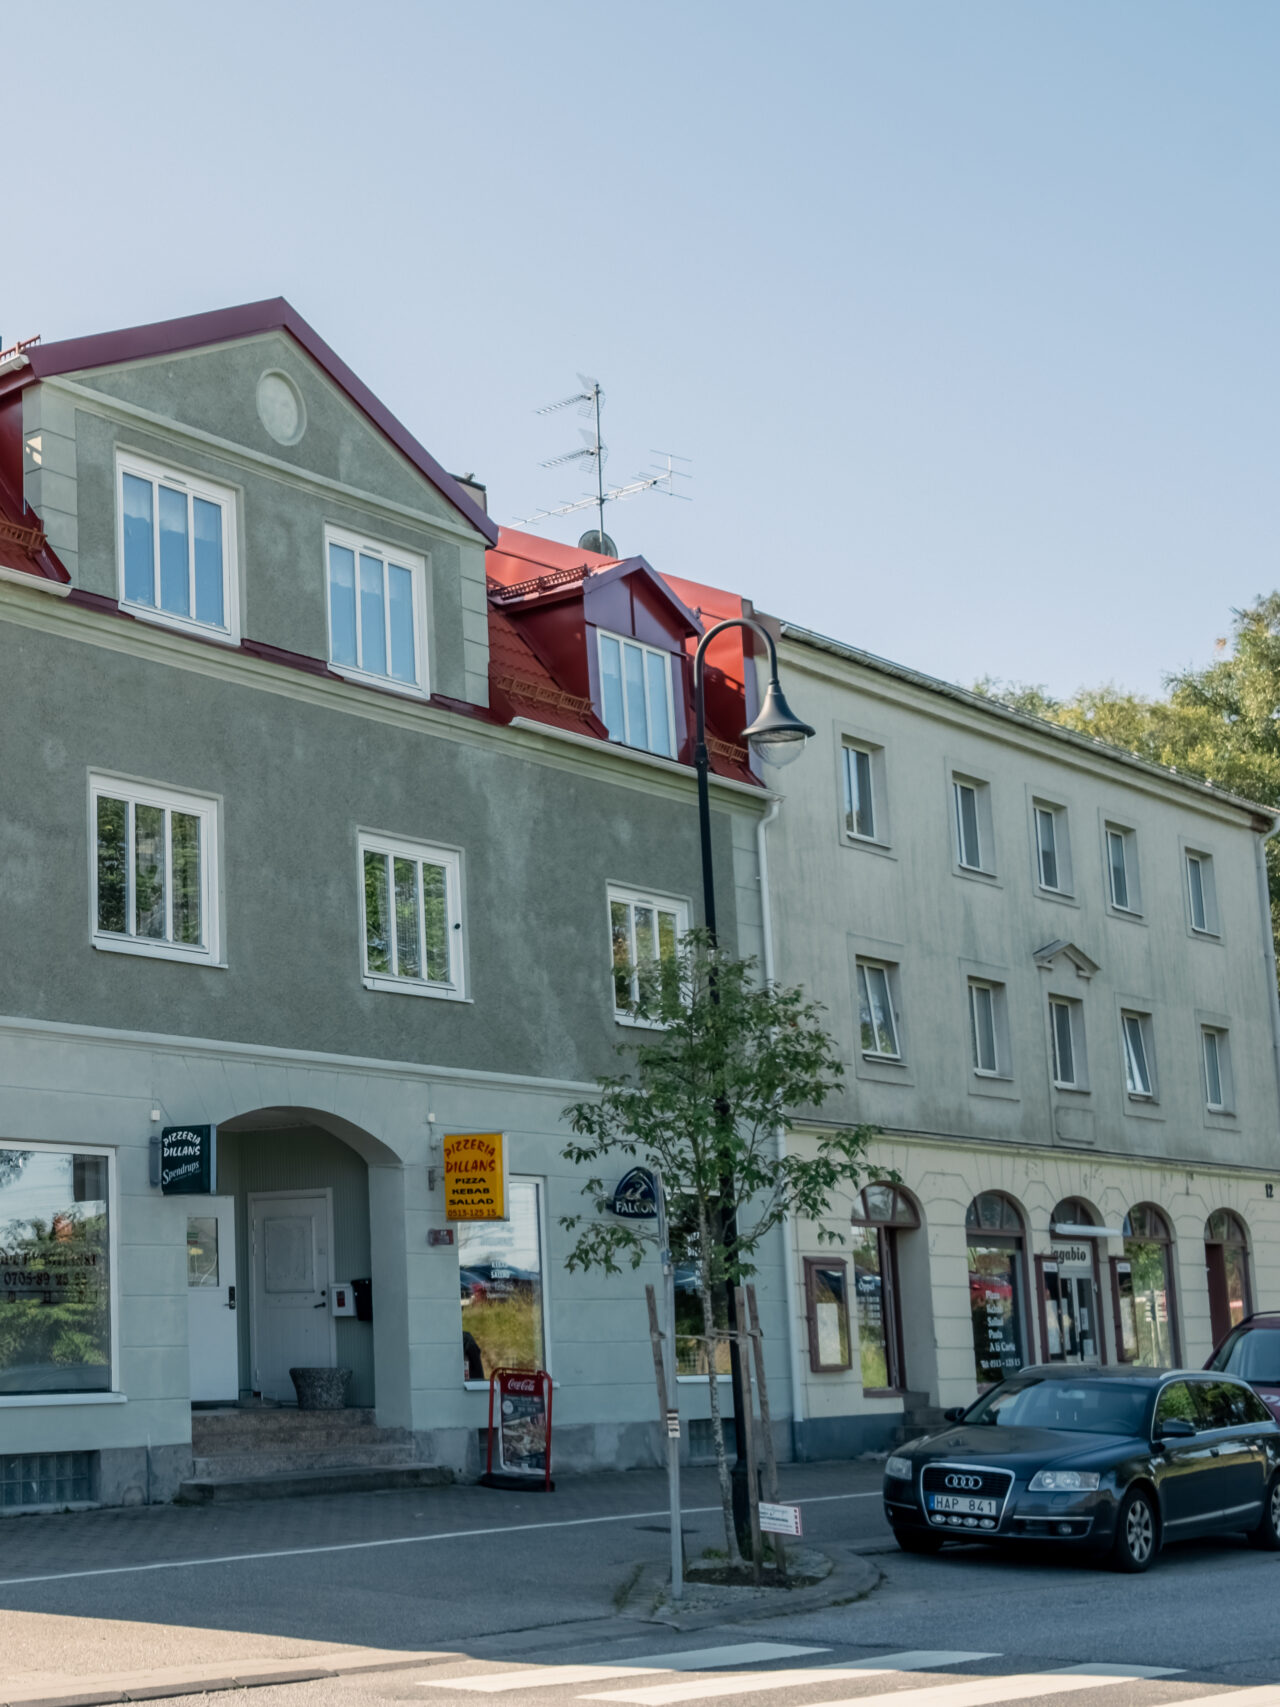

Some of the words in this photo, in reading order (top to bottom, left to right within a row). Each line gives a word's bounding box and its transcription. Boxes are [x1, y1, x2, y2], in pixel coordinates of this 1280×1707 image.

[163, 1131, 201, 1146] PIZZERIA
[163, 1145, 201, 1157] DILLANS
[444, 1139, 496, 1158] PIZZERIA
[163, 1161, 200, 1185] Spendrups
[445, 1159, 496, 1174] DILLANS
[452, 1187, 490, 1195] KEBAB
[1265, 1183, 1274, 1198] 12
[448, 1198, 495, 1206] SALLAD
[616, 1201, 658, 1214] FALCON
[487, 1208, 497, 1216] 15
[936, 1496, 959, 1510] HAP
[968, 1499, 993, 1513] 841
